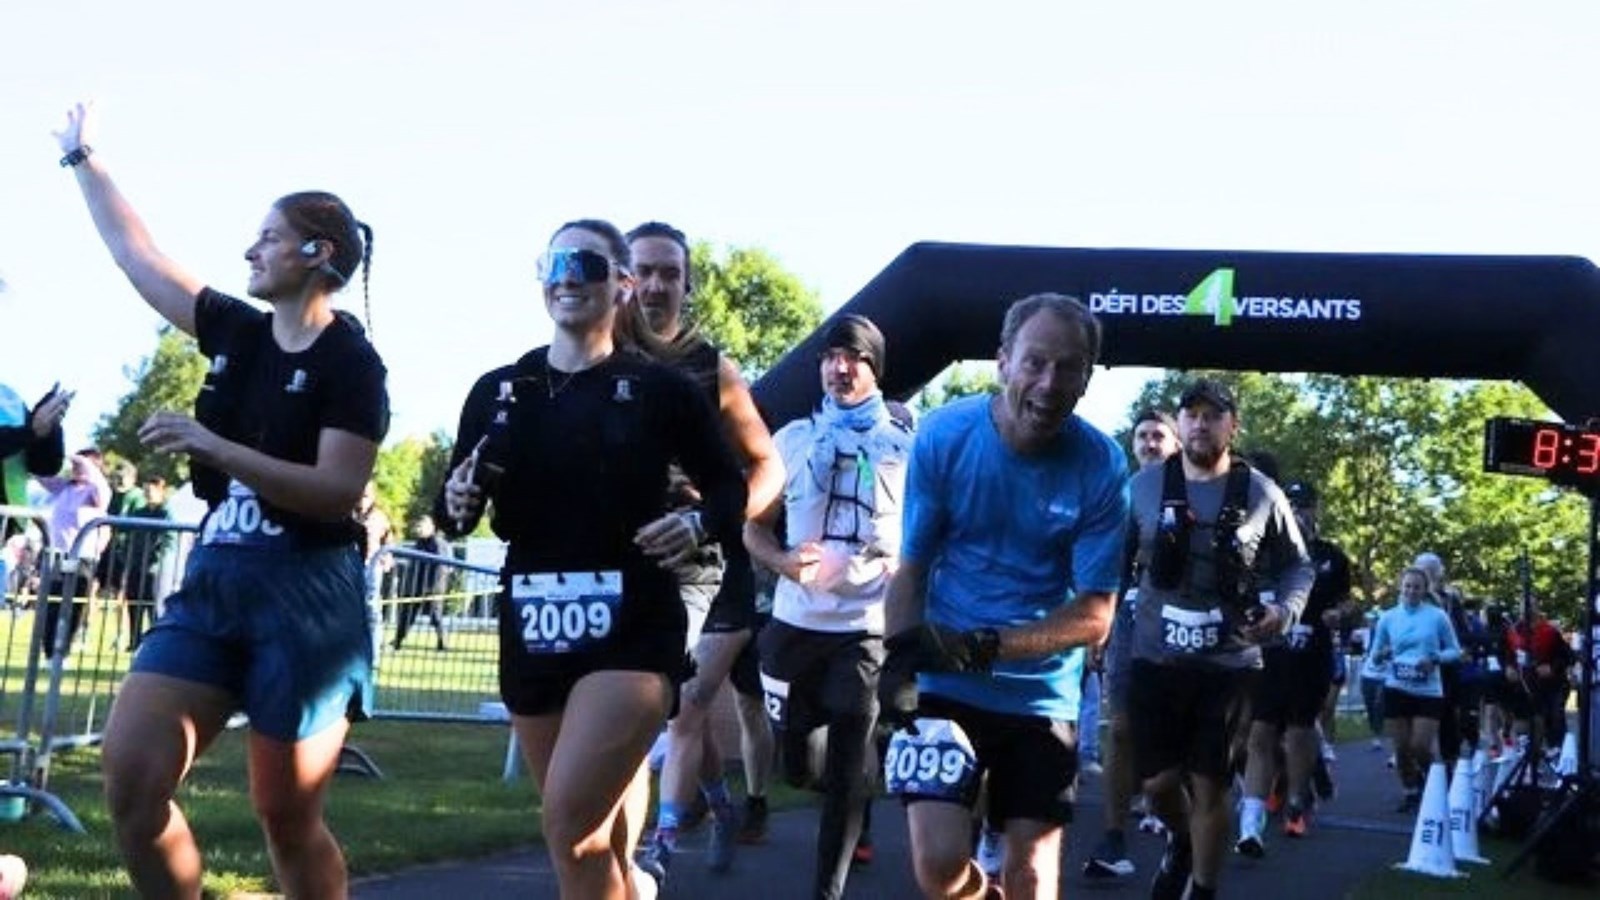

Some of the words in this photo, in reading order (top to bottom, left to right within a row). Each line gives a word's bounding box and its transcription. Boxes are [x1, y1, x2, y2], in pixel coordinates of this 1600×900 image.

[1089, 287, 1137, 313] DÉFI
[1142, 294, 1185, 314] DES
[1184, 267, 1235, 326] 4
[1232, 297, 1362, 320] VERSANTS
[521, 602, 612, 641] 2009
[1164, 622, 1219, 648] 2065
[885, 746, 966, 784] 2099
